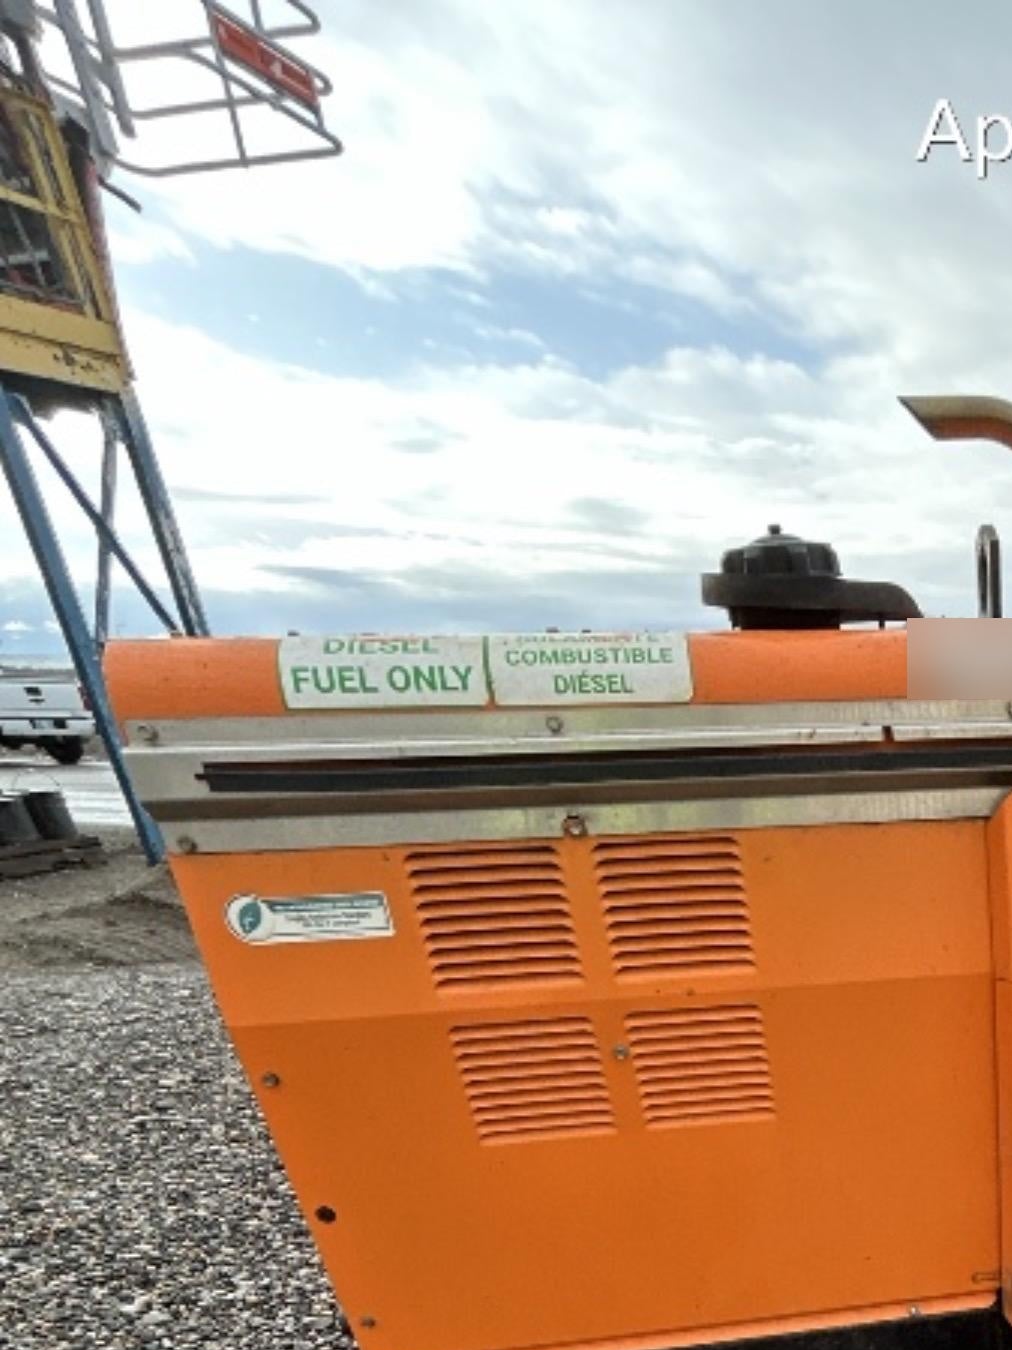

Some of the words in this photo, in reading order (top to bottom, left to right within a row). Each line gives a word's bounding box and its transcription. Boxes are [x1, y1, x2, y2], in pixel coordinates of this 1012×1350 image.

[506, 647, 674, 667] COMBUSTIBLE
[290, 665, 379, 694] FUEL
[386, 664, 472, 693] ONLY
[554, 670, 634, 694] DIÉSEL
